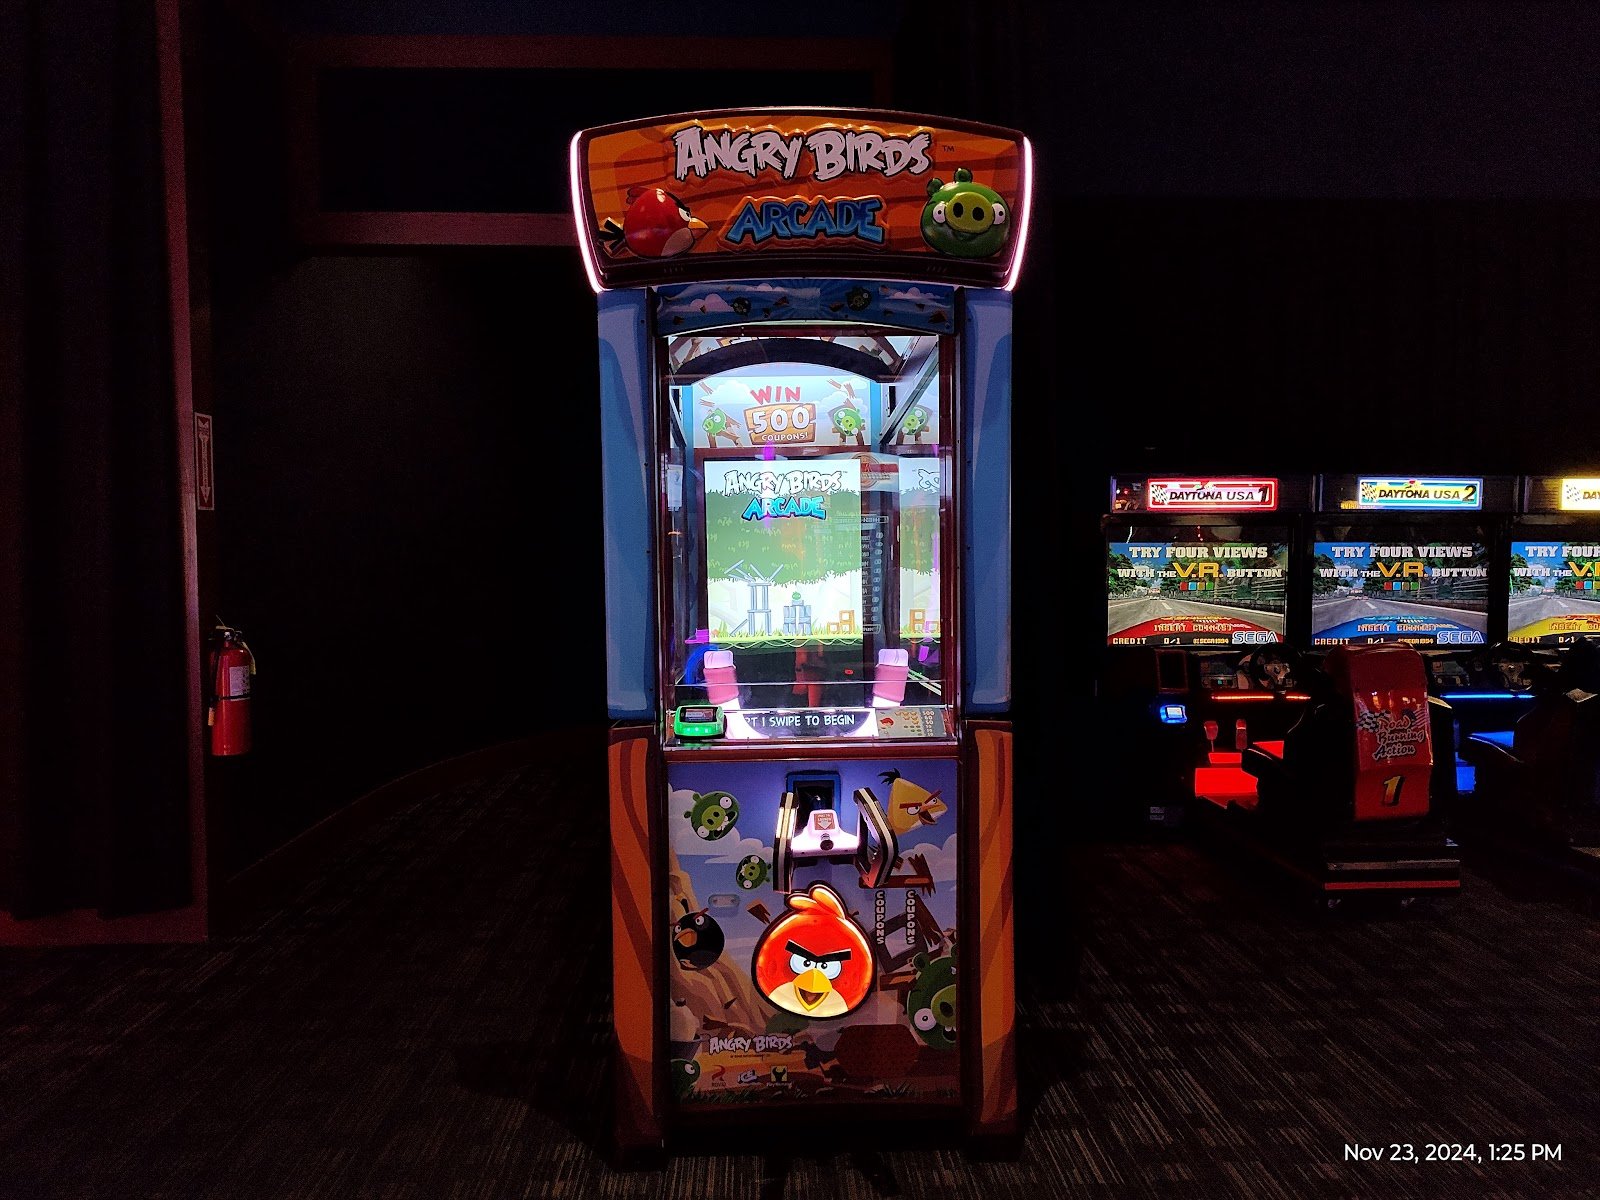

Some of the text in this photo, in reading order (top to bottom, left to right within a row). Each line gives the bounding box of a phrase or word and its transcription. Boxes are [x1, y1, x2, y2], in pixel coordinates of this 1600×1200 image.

[675, 127, 800, 181] ANGRY
[806, 130, 931, 181] BIRDS
[726, 199, 885, 243] ARCADE
[751, 385, 801, 405] WIN
[752, 406, 810, 433] 500
[761, 432, 809, 441] COUPONS!
[724, 470, 842, 496] ANGRY BIRDS
[1169, 486, 1269, 502] DAYTONA USA 1
[1378, 485, 1477, 502] DAYTONA USA 2
[741, 496, 826, 521] ARCADE
[1129, 547, 1268, 558] TRY FOUR VIEWS
[1332, 546, 1473, 558] TRY FOUR VIEWS
[1525, 546, 1560, 558] TRY
[1117, 568, 1155, 578] WITH
[1157, 569, 1176, 578] THE
[1226, 568, 1282, 578] BUTTON
[1320, 568, 1358, 578] WITH
[1361, 570, 1380, 578] THE
[1432, 567, 1487, 577] BUTTON
[1513, 568, 1550, 578] WITH
[1568, 562, 1600, 577] V.
[1232, 631, 1279, 645] SEGA
[1436, 631, 1484, 645] SEGA
[769, 715, 801, 727] SWIPE
[805, 715, 820, 726] TO
[824, 714, 855, 725] BEGIN
[1377, 715, 1412, 731] Road
[1376, 729, 1425, 744] Burning
[1372, 743, 1416, 760] Action
[1382, 775, 1405, 806] 1
[875, 890, 885, 945] COUPONS
[905, 890, 915, 944] COUPONS
[709, 1034, 793, 1055] ANGRY BIRDS
